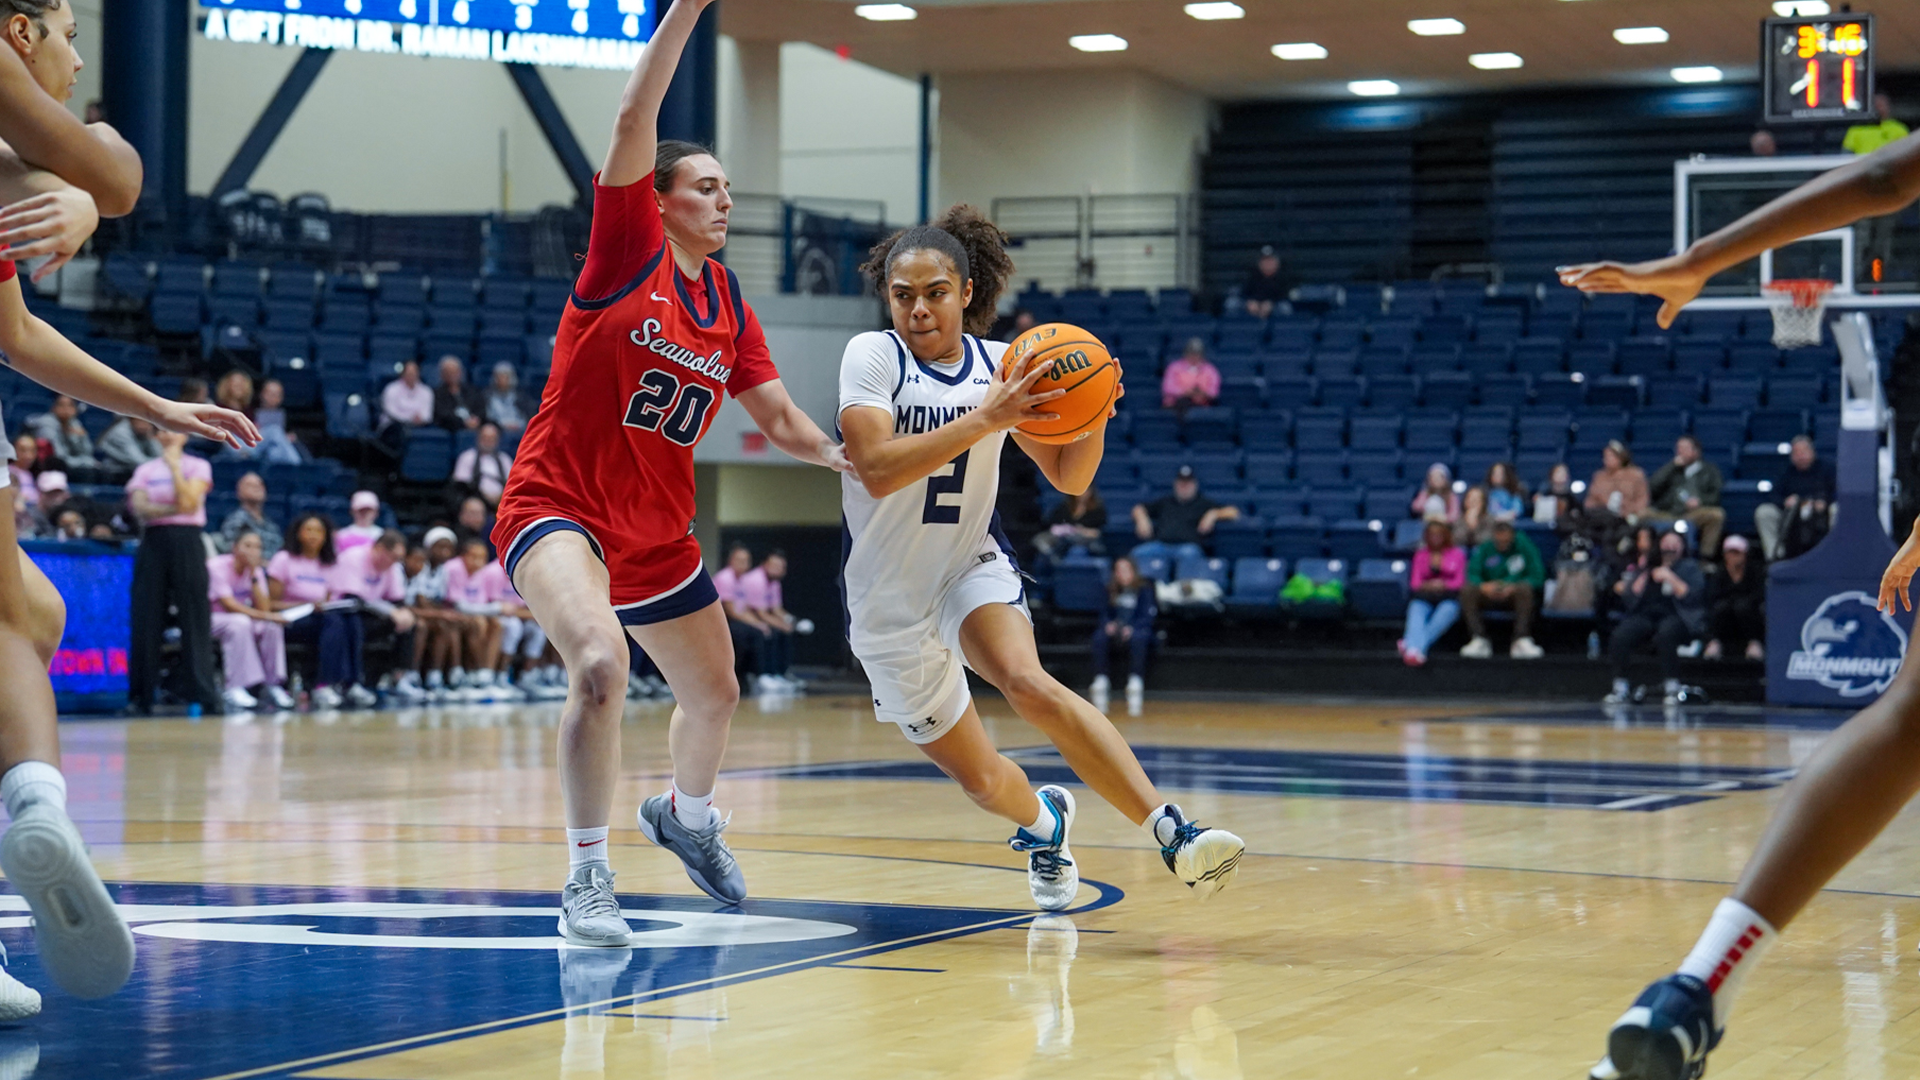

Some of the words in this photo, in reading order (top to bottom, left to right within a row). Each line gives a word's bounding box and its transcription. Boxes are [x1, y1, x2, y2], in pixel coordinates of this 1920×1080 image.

[204, 7, 227, 40] A
[227, 8, 283, 45] GIFT
[283, 13, 355, 50] FROM
[1806, 57, 1855, 107] 11
[630, 318, 731, 384] Seawolve
[973, 378, 990, 386] CAA
[622, 368, 715, 447] 20
[922, 448, 970, 524] 2
[1792, 654, 1902, 677] MONMOUT
